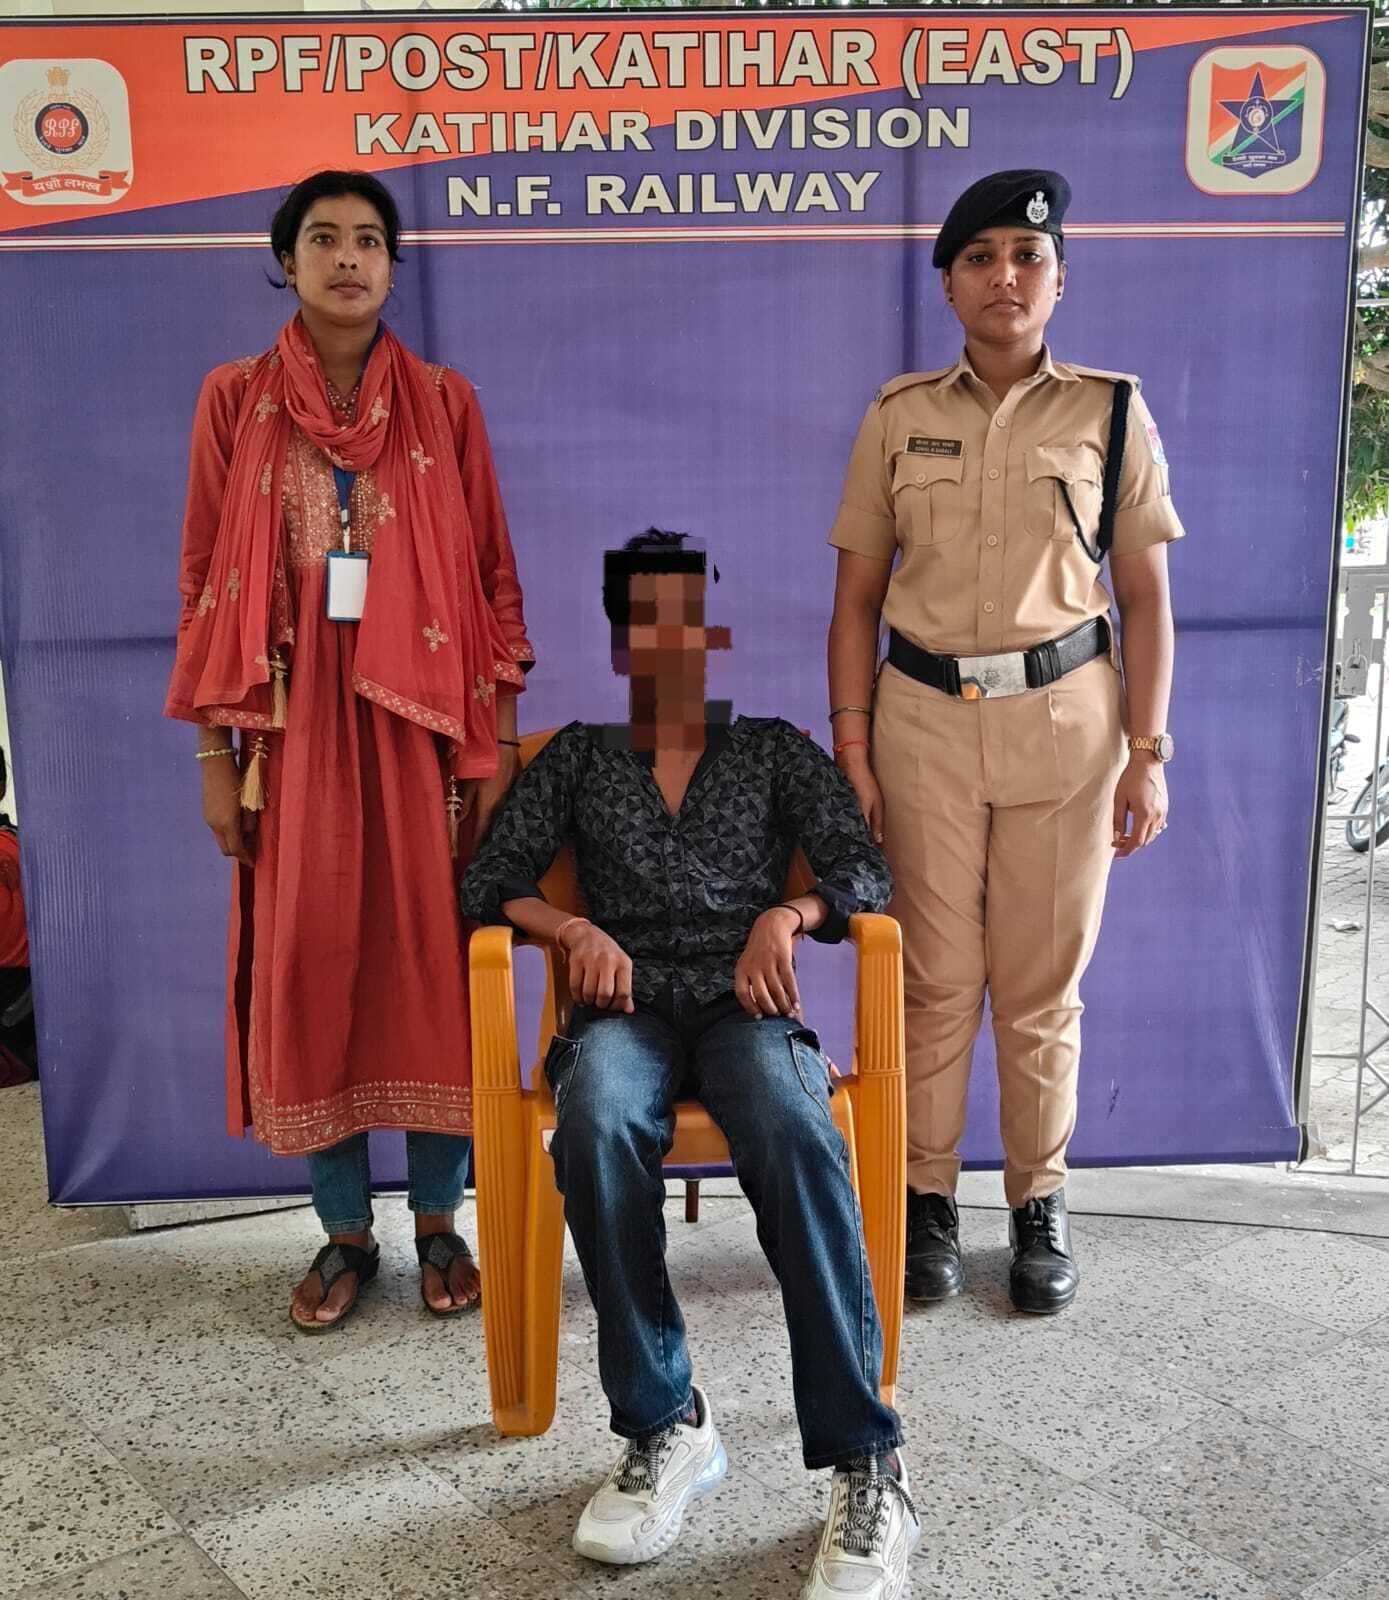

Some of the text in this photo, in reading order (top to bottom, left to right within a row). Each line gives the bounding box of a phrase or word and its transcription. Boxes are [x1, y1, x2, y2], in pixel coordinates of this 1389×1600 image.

[184, 28, 1135, 100] RPF/POST/KATIHAR (EAST)
[355, 107, 970, 155] KATIHAR DIVISION
[447, 171, 881, 216] N.F. RAILWAY
